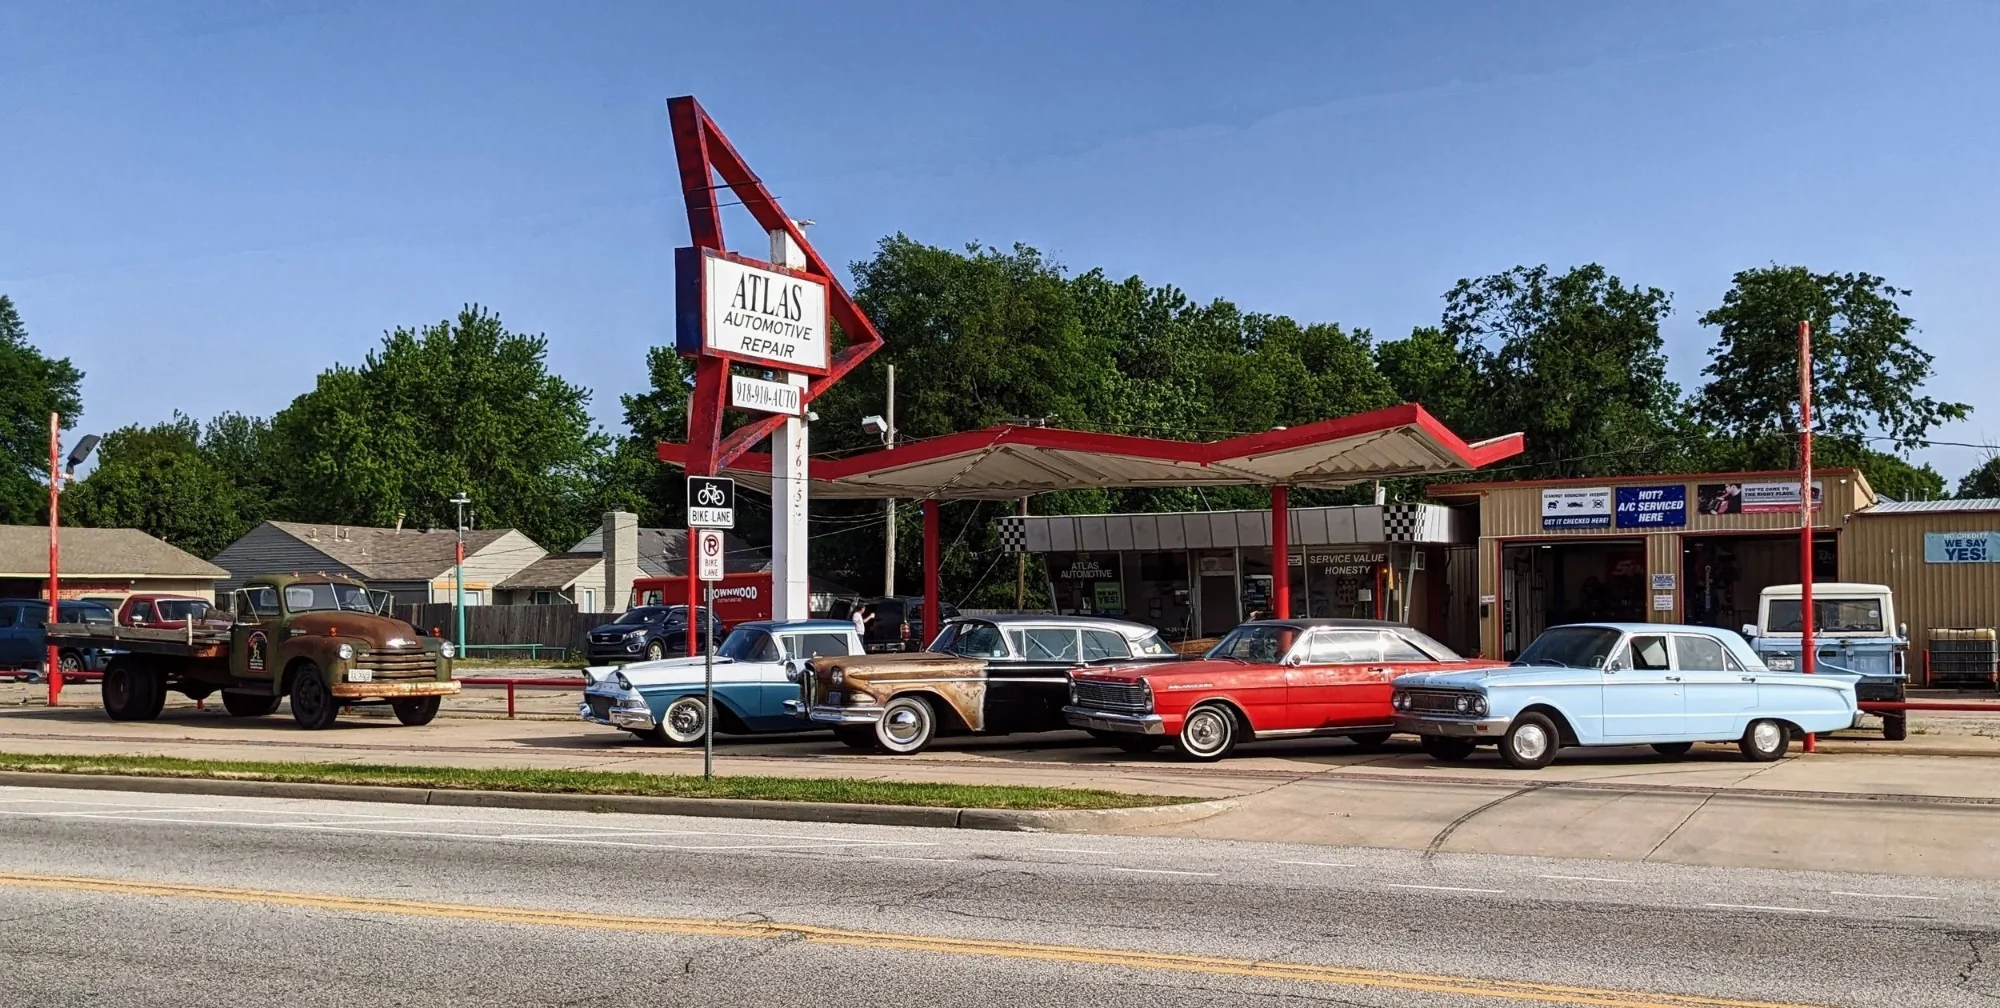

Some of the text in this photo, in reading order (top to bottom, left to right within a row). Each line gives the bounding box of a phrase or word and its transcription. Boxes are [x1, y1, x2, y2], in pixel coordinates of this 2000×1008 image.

[731, 271, 802, 322] ATLAS
[723, 311, 812, 341] AUTOMOTIVE
[740, 336, 795, 358] REPAIR
[736, 381, 797, 409] 918-910-AUTO
[1638, 490, 1664, 500] HOT?
[1617, 500, 1684, 512] A/C SERVICED
[692, 510, 731, 523] BIKE LANE
[1562, 517, 1590, 525] CHECKED
[1638, 512, 1664, 522] HERE
[1944, 539, 1987, 548] WE SAY
[1310, 554, 1351, 564] SERVICE
[1353, 553, 1385, 562] VALUE
[1944, 548, 1987, 560] YES!
[705, 558, 718, 567] BIKE
[1071, 561, 1099, 570] ATLAS
[705, 568, 718, 576] LANE
[1060, 569, 1112, 578] AUTOMOTIVE
[1325, 565, 1371, 575] HONESTY
[703, 586, 758, 602] OWNWOOD
[1098, 596, 1118, 604] YES!
